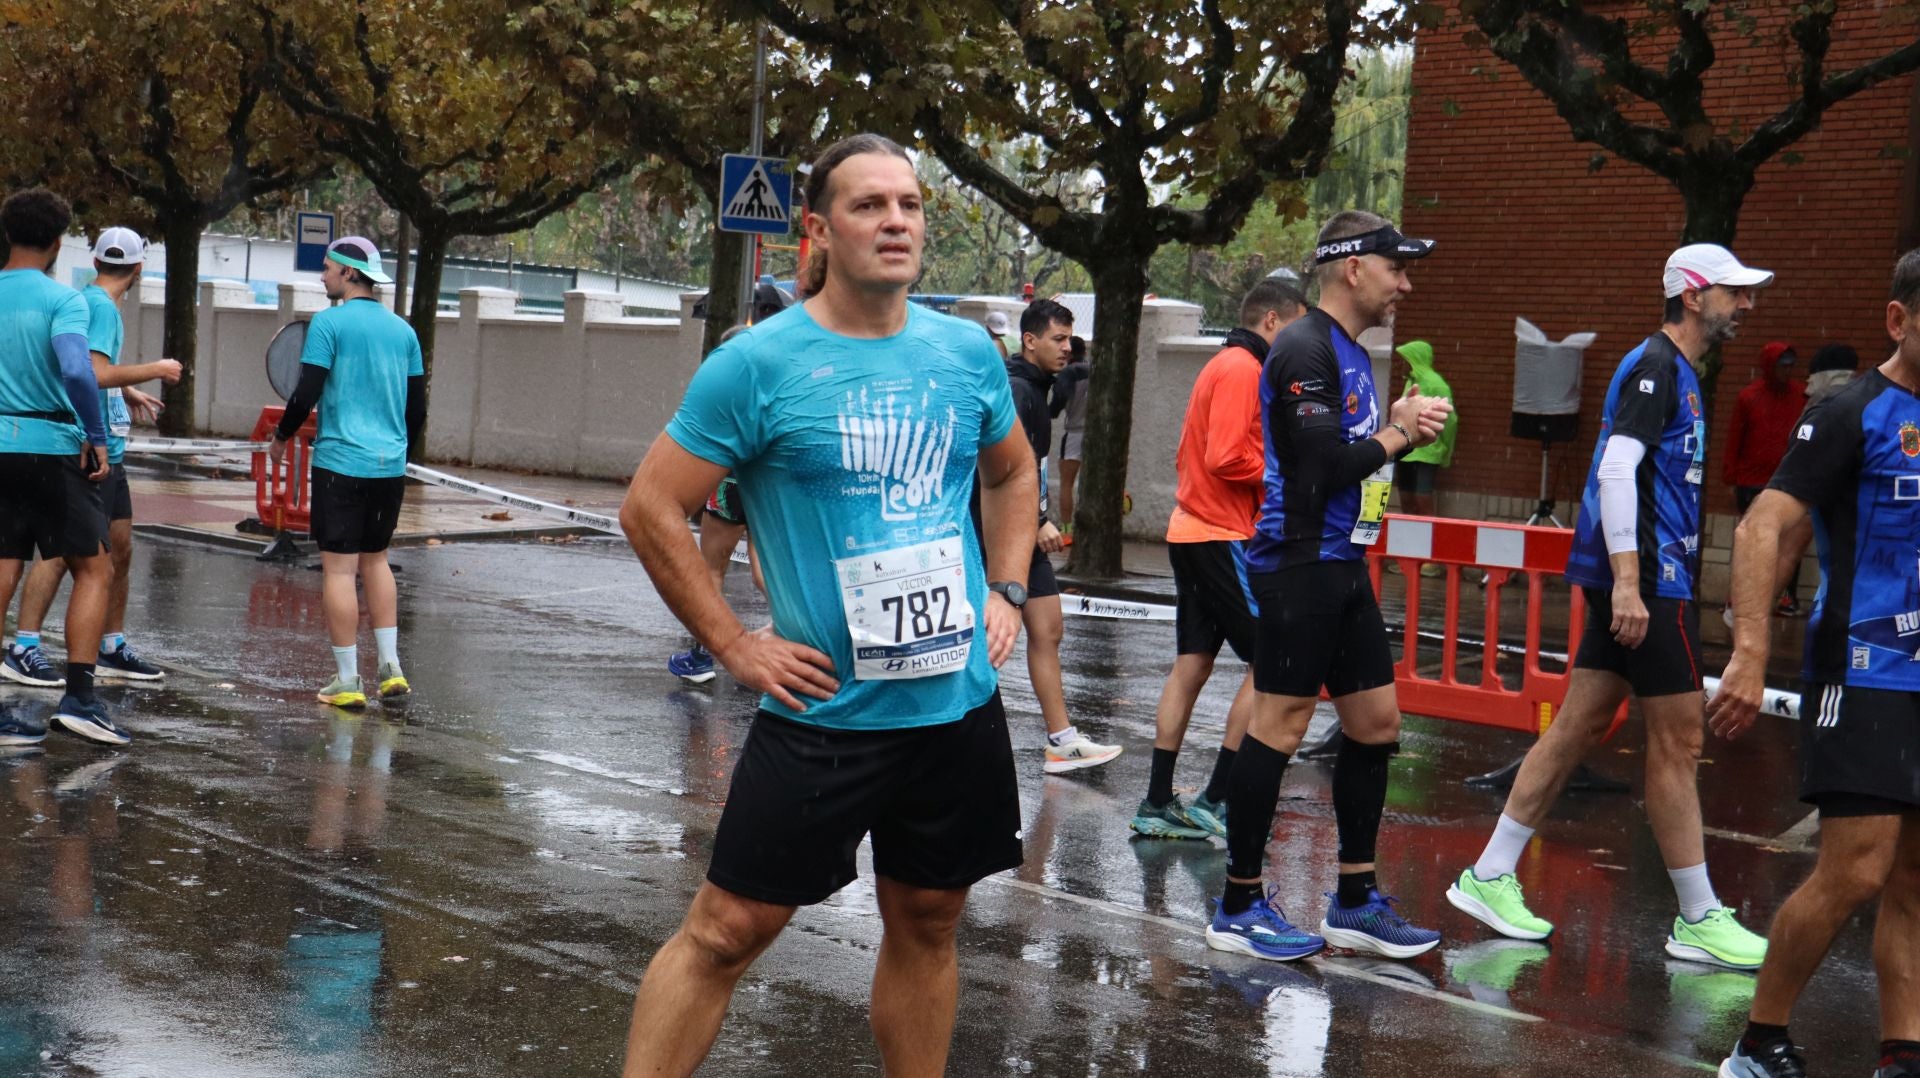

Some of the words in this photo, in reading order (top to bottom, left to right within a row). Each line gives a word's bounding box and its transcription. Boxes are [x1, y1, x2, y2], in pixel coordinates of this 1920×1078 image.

[1316, 240, 1362, 258] SPORT
[858, 474, 880, 483] 10km
[881, 586, 957, 643] 782
[1094, 602, 1151, 617] kutxabank
[912, 647, 967, 668] HYUNDAI
